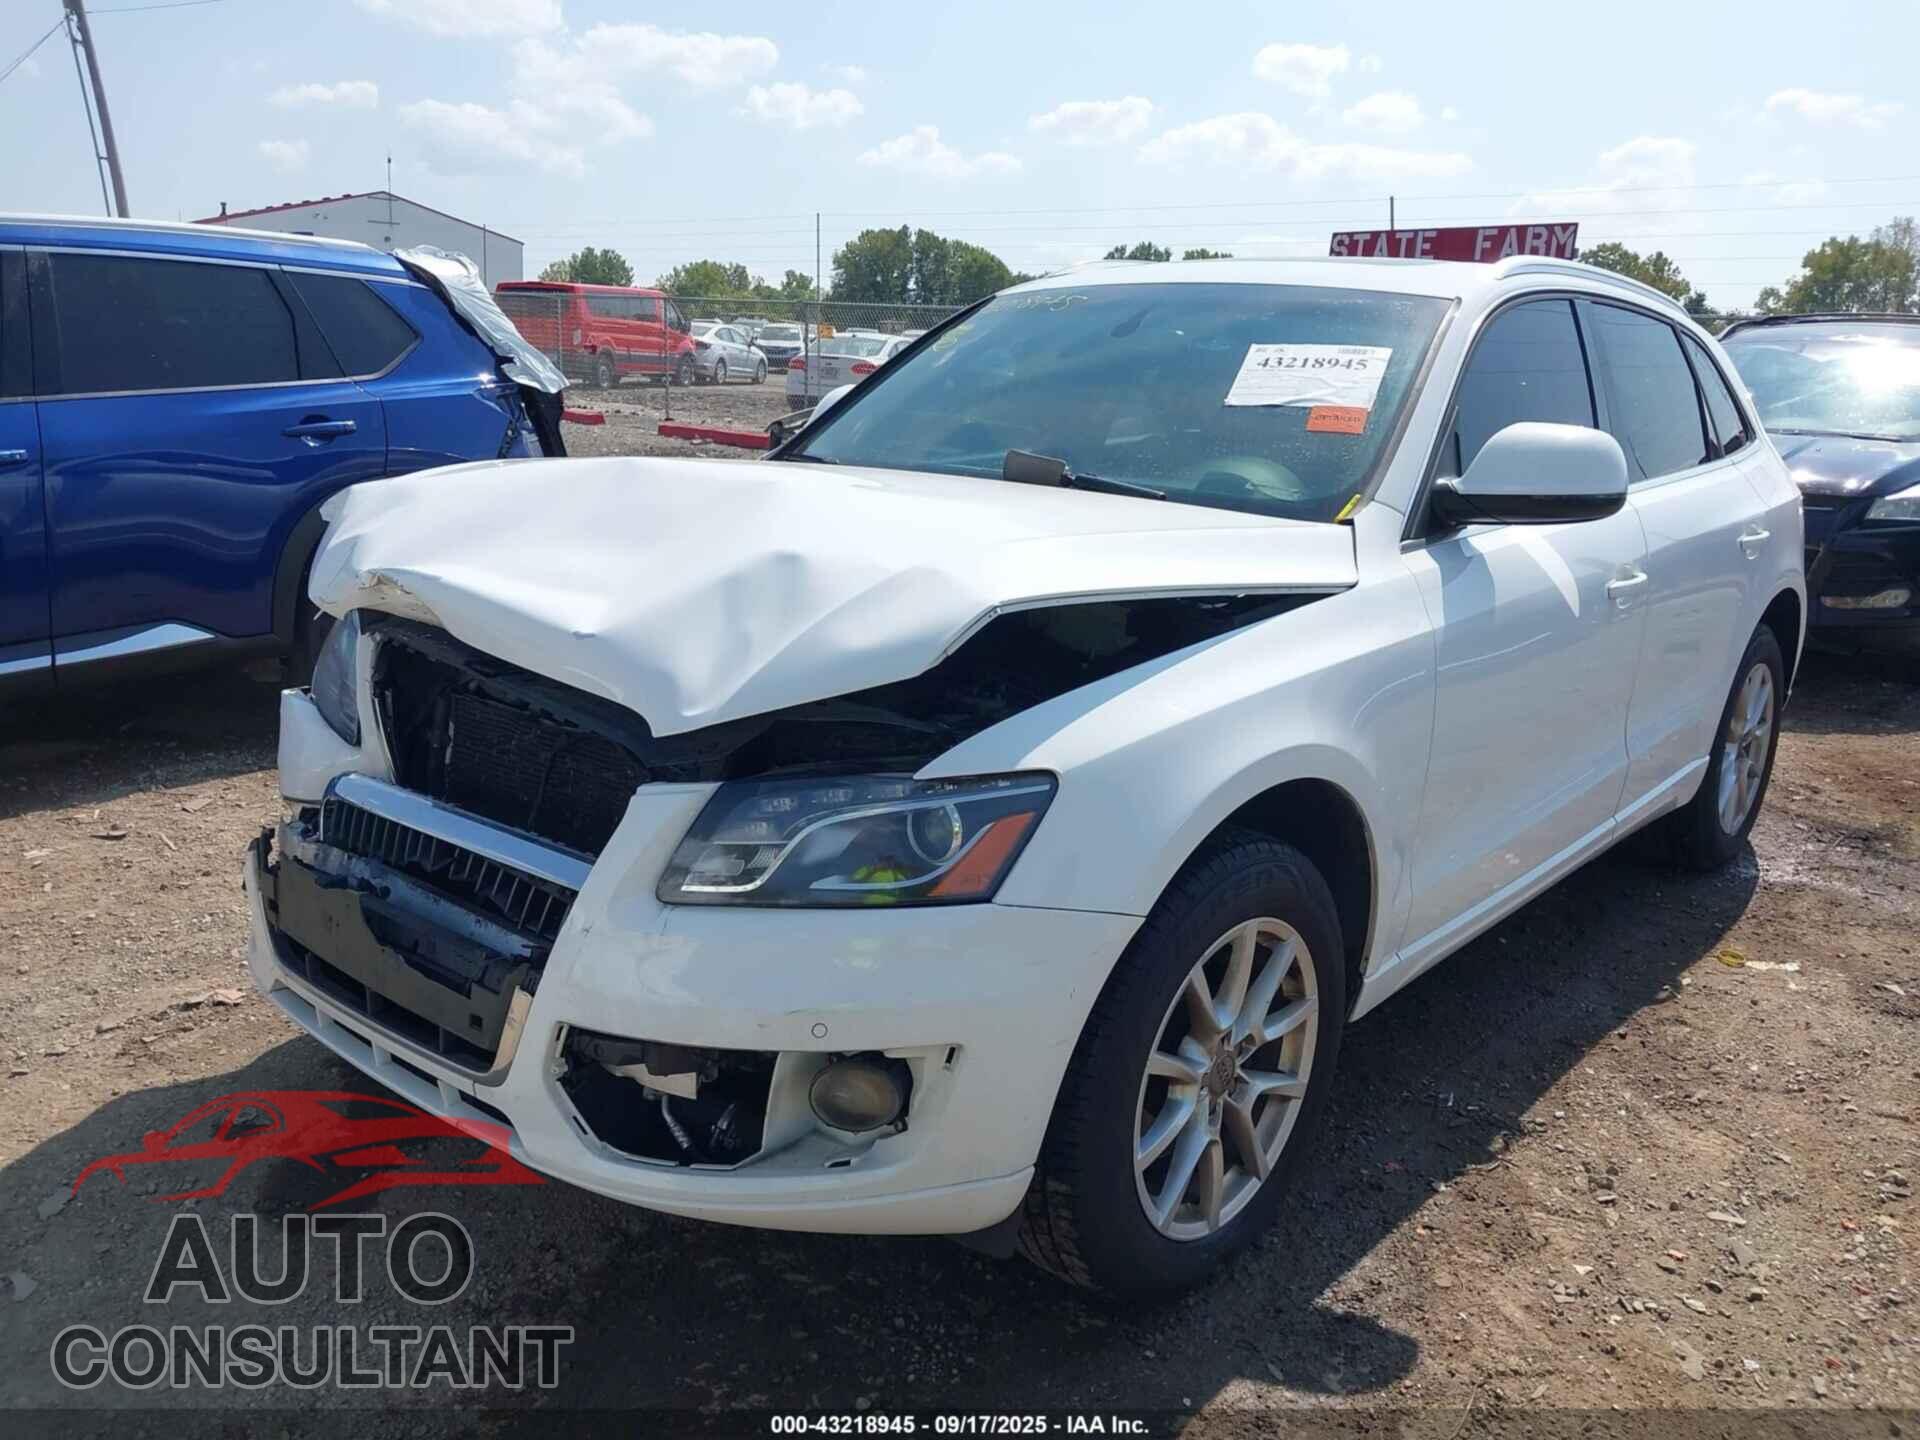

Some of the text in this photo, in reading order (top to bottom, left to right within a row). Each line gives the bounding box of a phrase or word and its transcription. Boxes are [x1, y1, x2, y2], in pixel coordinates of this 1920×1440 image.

[1330, 225, 1578, 261] STATE FARM
[1256, 356, 1369, 371] 43218945
